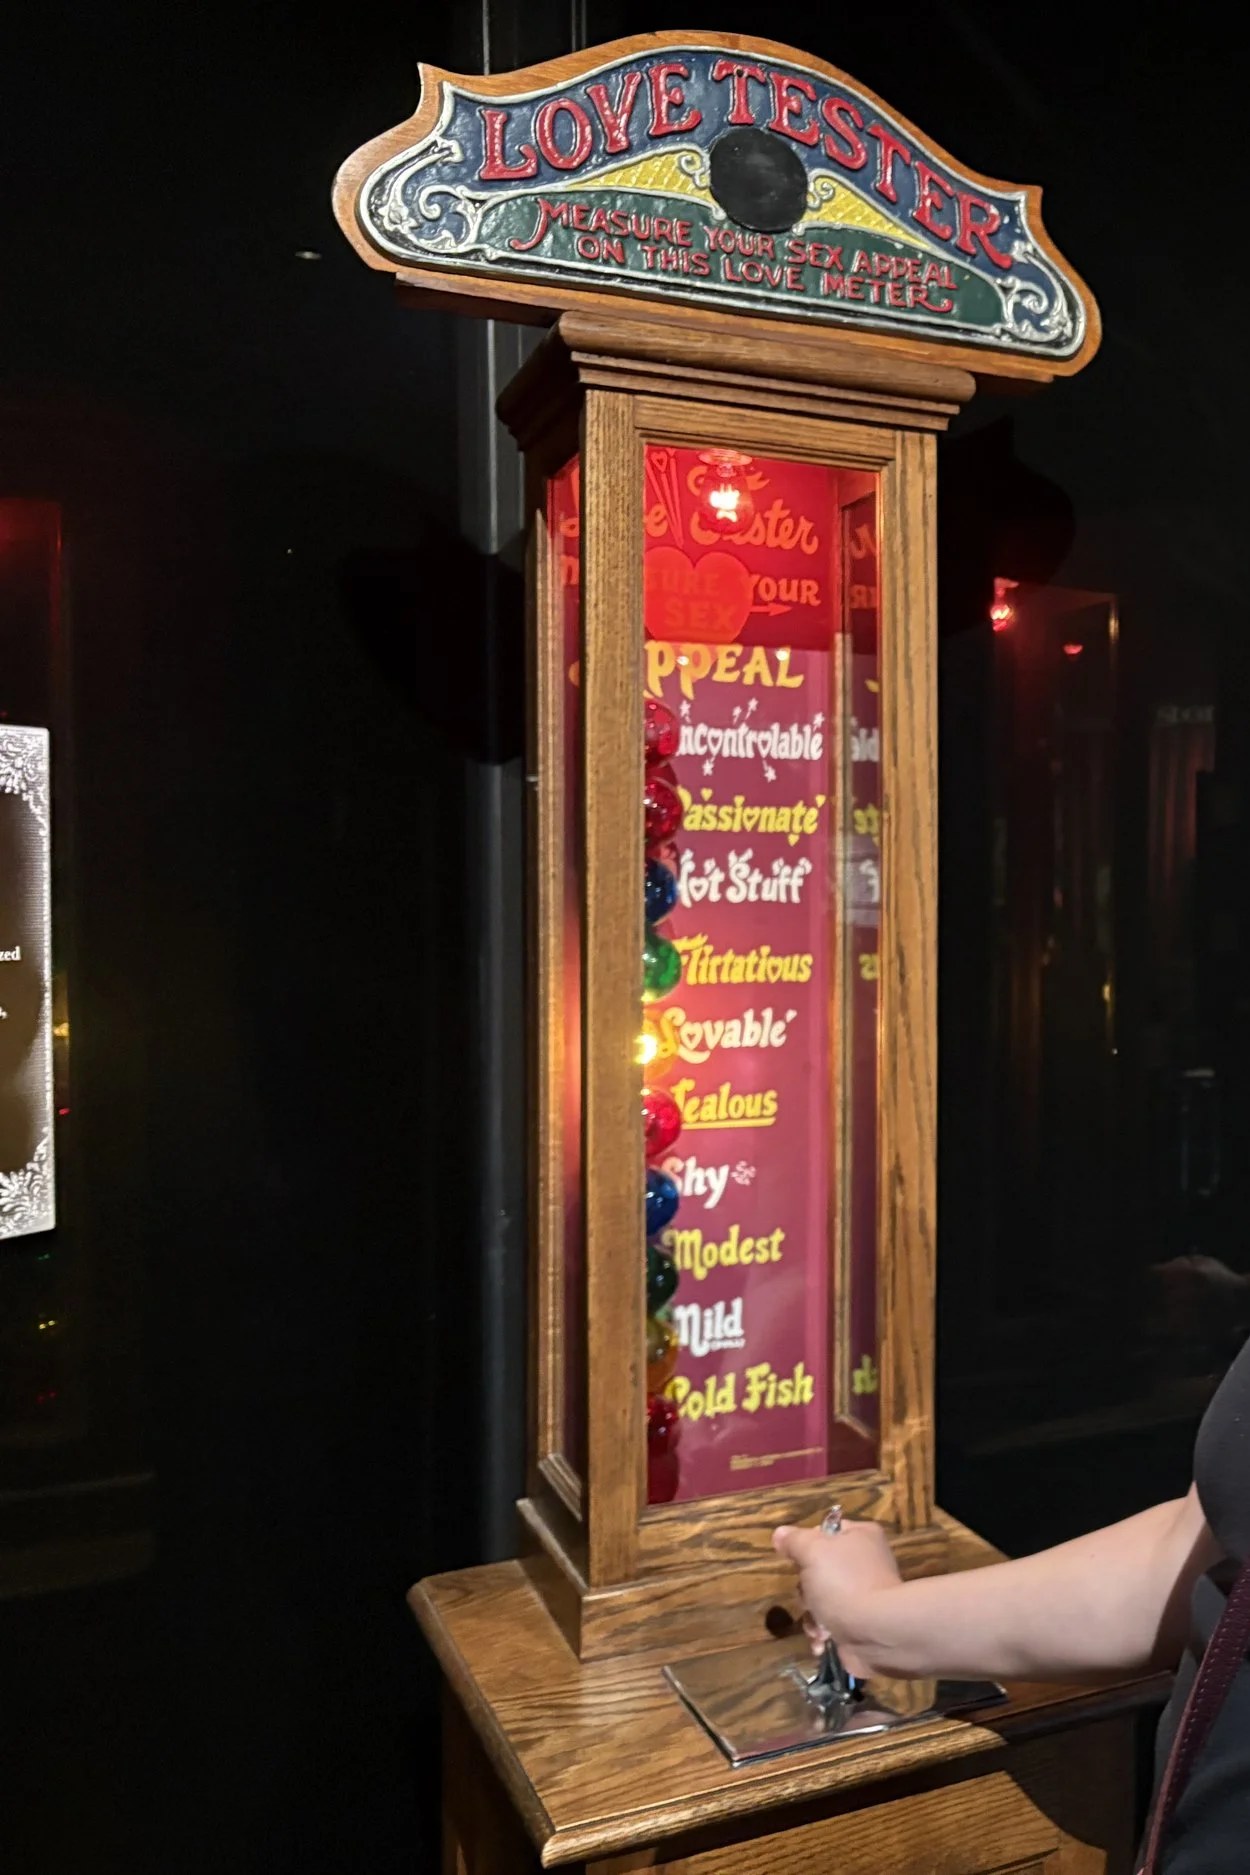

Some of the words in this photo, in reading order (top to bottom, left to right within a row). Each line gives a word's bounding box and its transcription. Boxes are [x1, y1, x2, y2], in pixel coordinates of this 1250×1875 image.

[479, 61, 703, 181] LOVE
[711, 58, 1013, 270] TESTER
[508, 197, 693, 251] MEASURE
[704, 225, 776, 261] YOUR
[786, 239, 845, 272] SEX
[851, 249, 958, 290] APPEAL
[576, 235, 626, 265] ON
[641, 244, 711, 276] THIS
[722, 256, 805, 291] LOVE
[821, 271, 954, 314] METER
[643, 640, 805, 699] PPEAL
[676, 721, 824, 760] ncontrolable
[726, 848, 813, 904] Stuff
[661, 1223, 786, 1281] Modest
[741, 1361, 815, 1413] Fish
